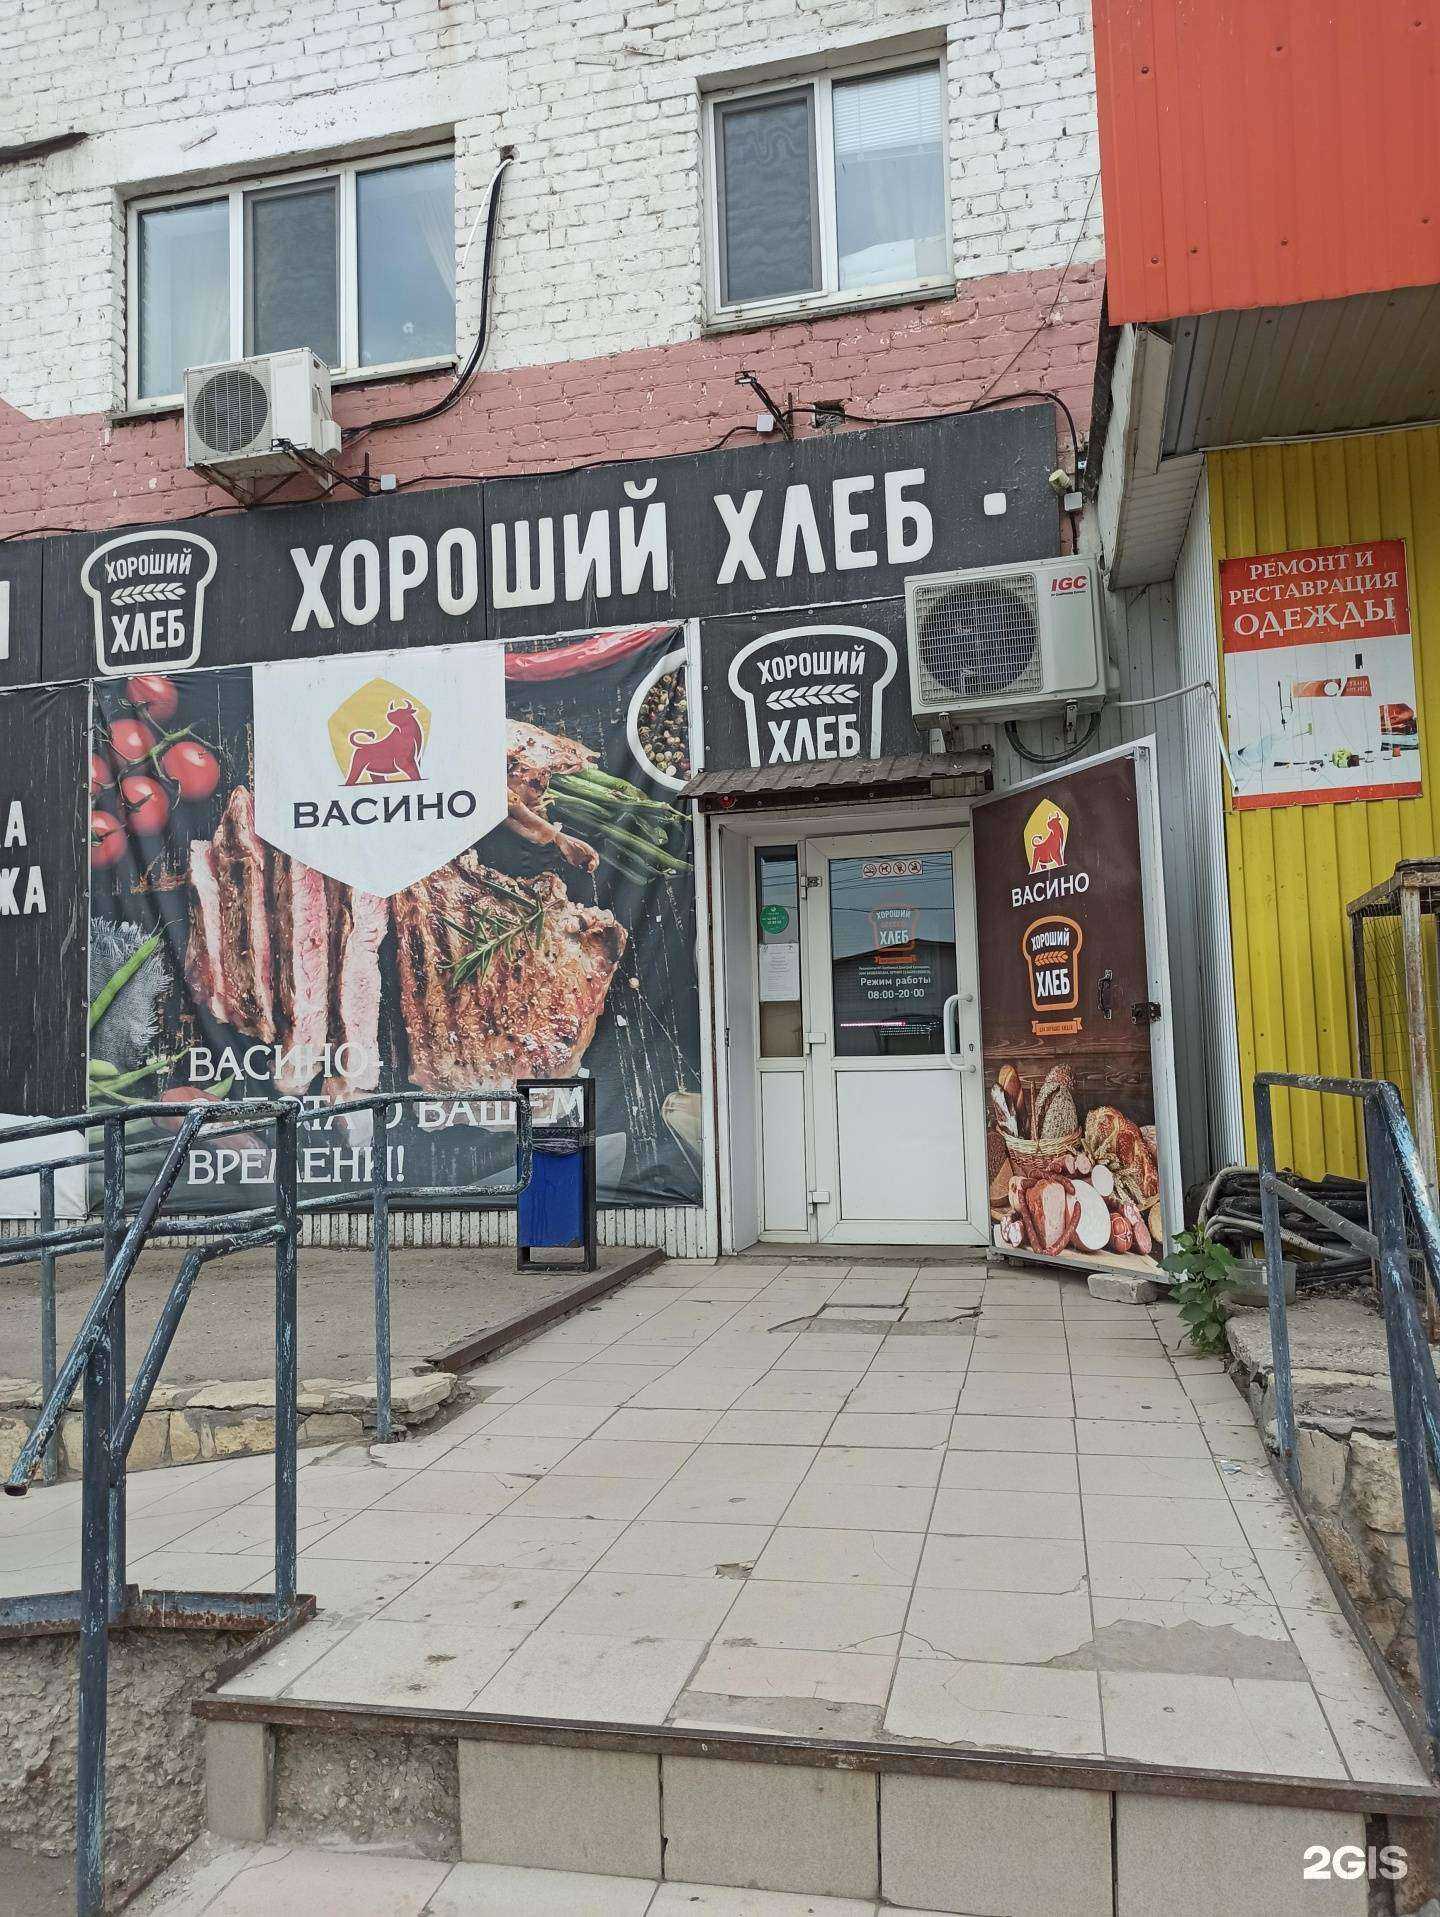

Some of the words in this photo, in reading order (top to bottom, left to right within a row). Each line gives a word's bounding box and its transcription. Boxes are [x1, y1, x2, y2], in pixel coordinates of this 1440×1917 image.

[104, 548, 192, 584] ХОРОШИЙ
[290, 478, 669, 632] ХОРОШИЙ
[713, 467, 934, 584] ХЛЕБ
[1250, 552, 1350, 581] РЕМОНТ
[1355, 550, 1374, 567] И
[1051, 575, 1087, 592] IGC
[1228, 571, 1399, 605] РЕСТАВРАЦИЯ
[110, 609, 186, 654] ХЛЕБ
[1234, 598, 1396, 638] ОДЕЖДЫ
[756, 645, 866, 686] ХОРОШИЙ
[767, 713, 861, 764] ХЛЕБ
[292, 790, 478, 830] ВАСИНО
[1011, 872, 1090, 908] ВАСИНО
[880, 930, 909, 945] ХЛЕБ
[1030, 927, 1070, 951] ХОРОШИЙ
[860, 977, 892, 986] Режим
[895, 975, 931, 987] работы
[1035, 968, 1070, 997] ХЛЕБ
